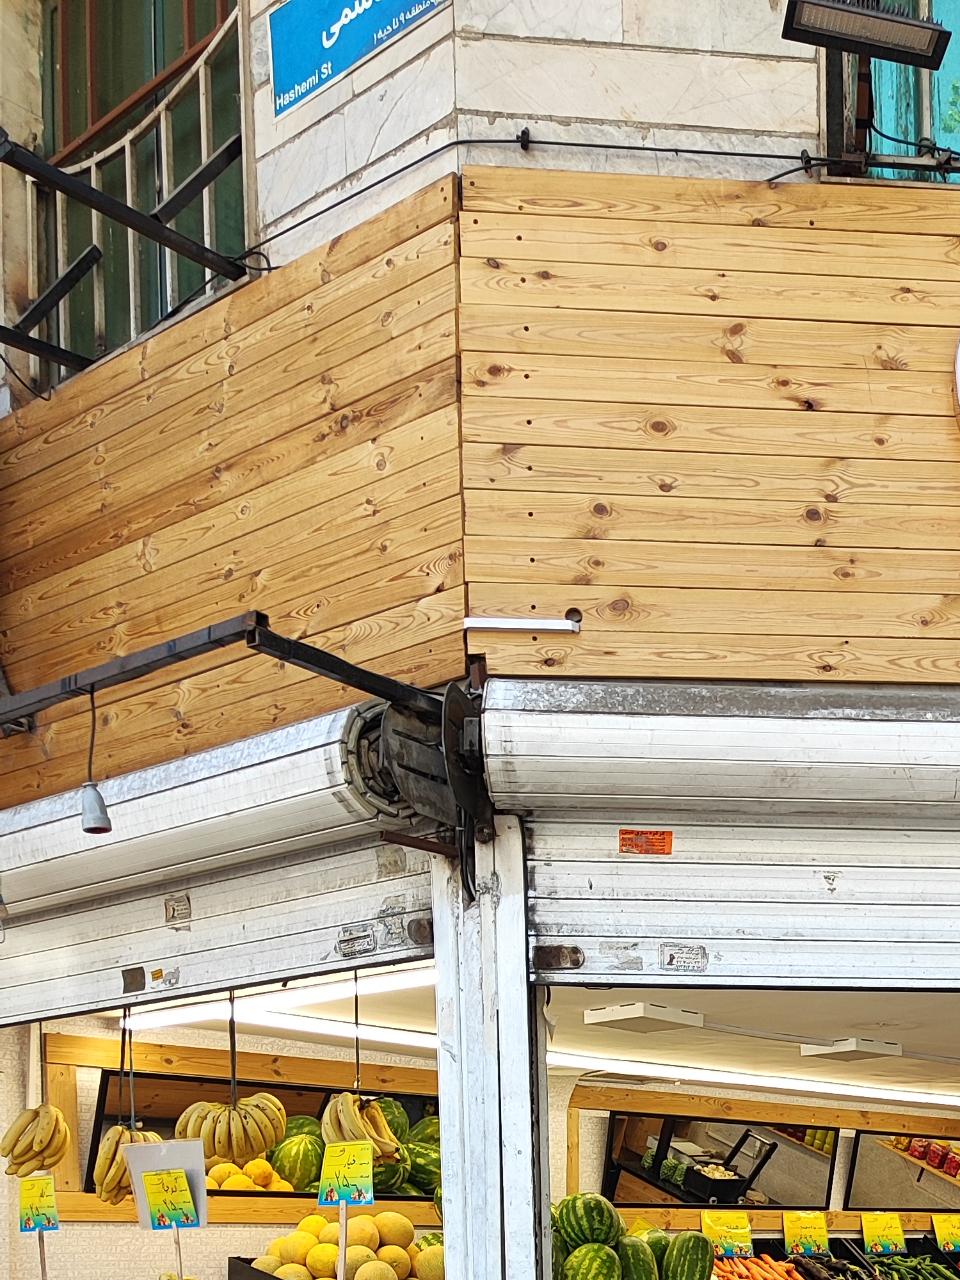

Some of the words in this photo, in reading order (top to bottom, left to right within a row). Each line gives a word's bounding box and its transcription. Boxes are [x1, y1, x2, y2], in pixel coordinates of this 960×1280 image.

[377, 18, 400, 39] ناحیه
[276, 69, 319, 110] Hashemi
[320, 61, 332, 80] St
